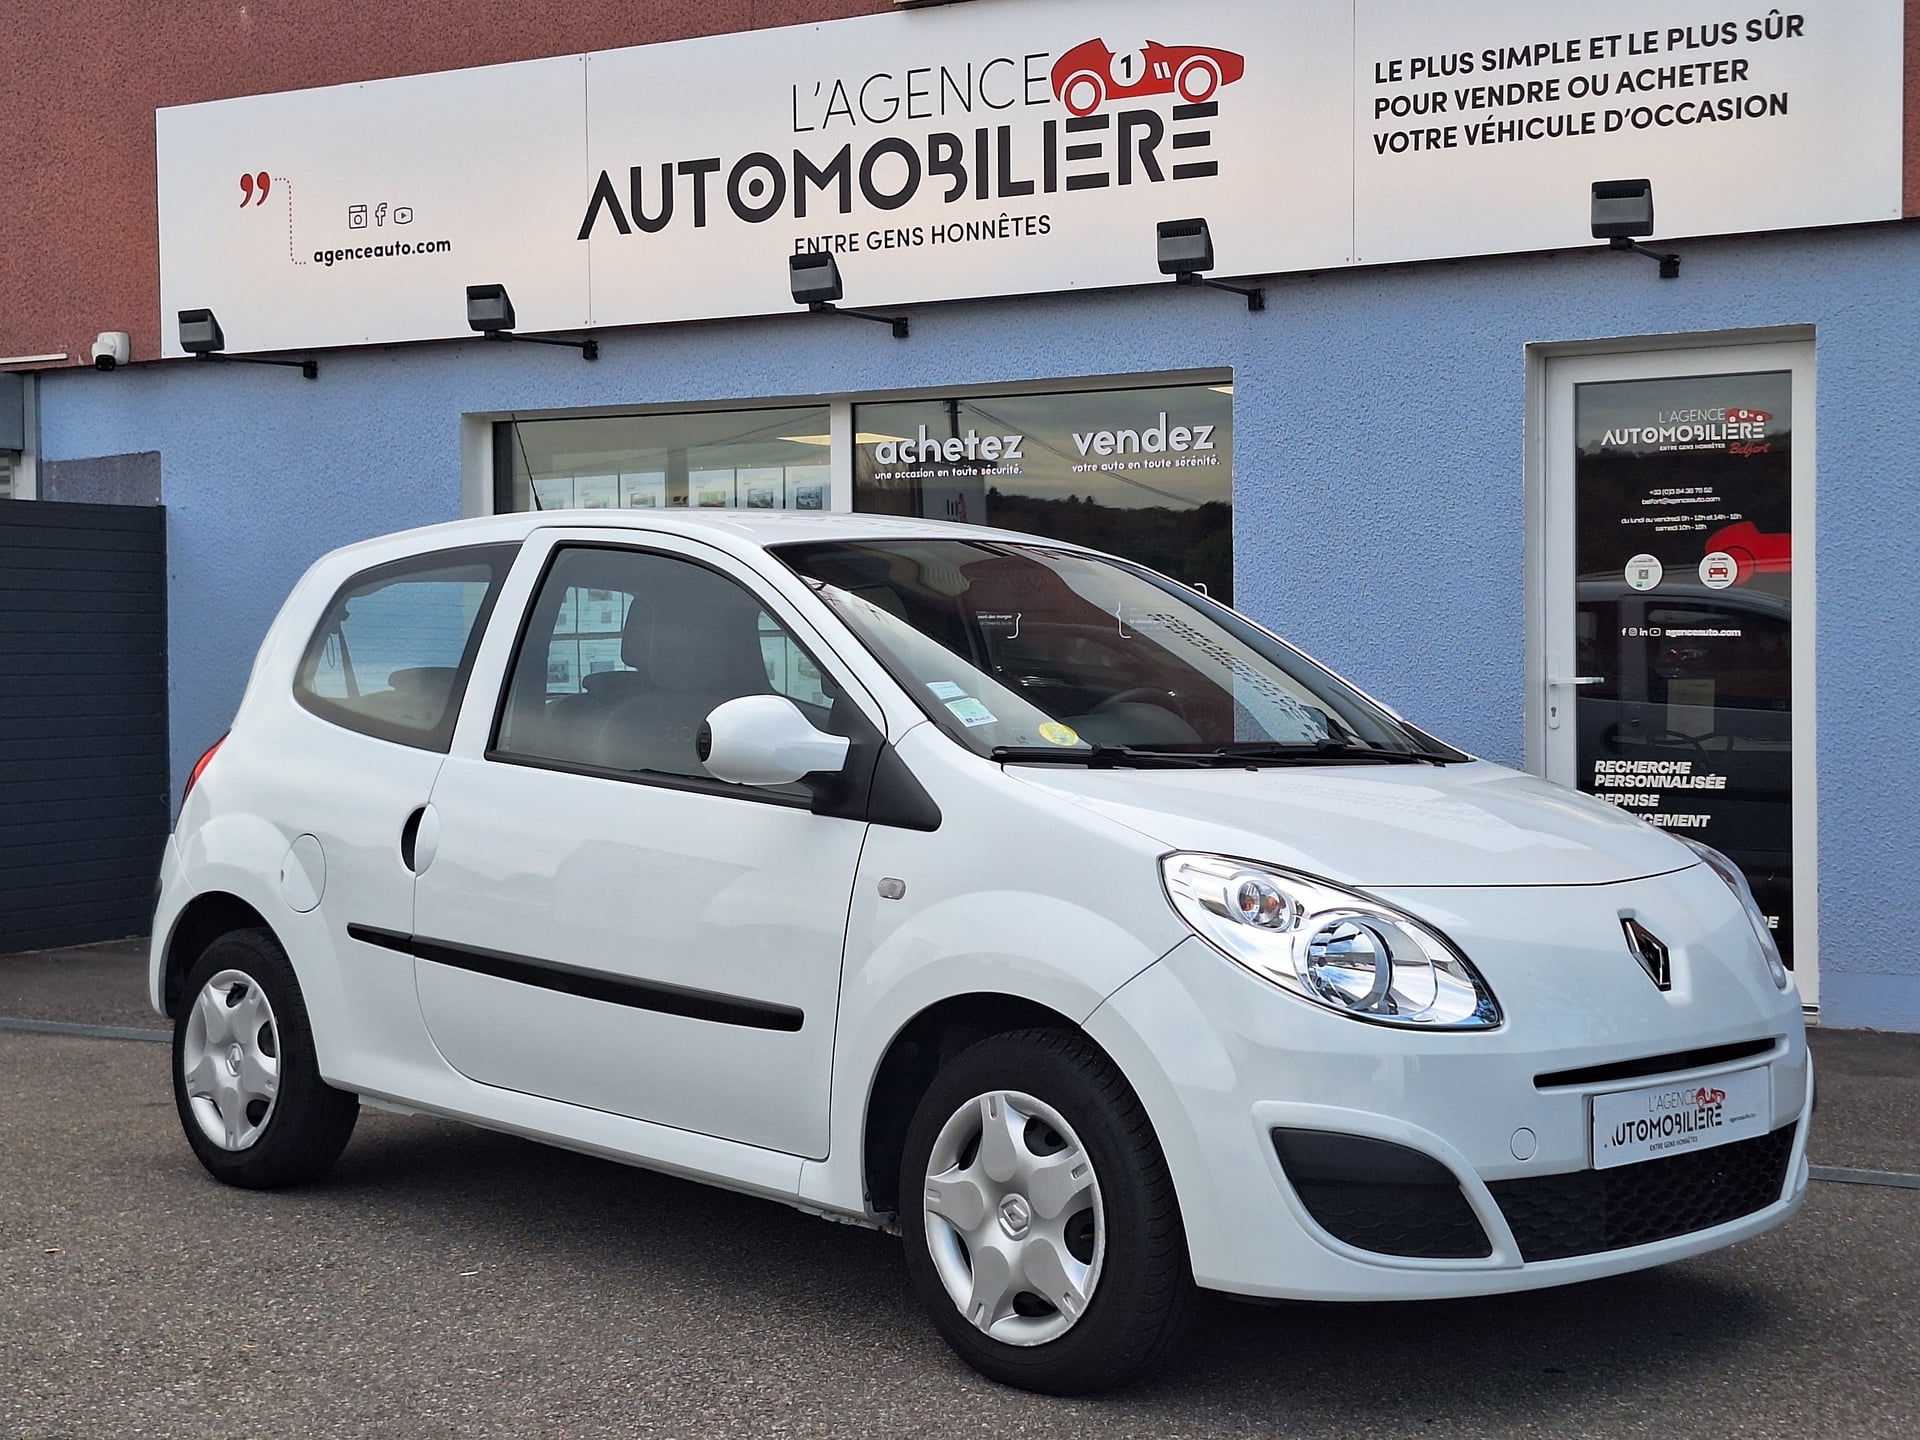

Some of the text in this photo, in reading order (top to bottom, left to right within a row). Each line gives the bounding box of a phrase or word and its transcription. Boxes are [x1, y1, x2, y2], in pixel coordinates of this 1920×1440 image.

[1375, 9, 1805, 83] LE PLUS SIMPLE ET LE PLUS SÛR
[793, 52, 1051, 133] L'AGENCE
[1374, 58, 1749, 119] POUR VENDRE OU ACHETER
[1373, 92, 1788, 155] VOTRE VÉHICULE D'OCCASION
[313, 239, 451, 267] agenceauto.com
[794, 212, 1051, 254] ENTRE GENS HONNÊTES
[874, 424, 1024, 466] achetez
[1072, 411, 1216, 457] vendez
[875, 472, 892, 480] une
[895, 470, 936, 479] occasion
[952, 466, 978, 477] toute
[1072, 462, 1098, 473] votre
[1101, 461, 1126, 471] auto
[1128, 461, 1141, 470] en
[1144, 458, 1172, 469] toute
[1594, 760, 1692, 774] RECHERCHE
[1594, 773, 1727, 789] PERSONNALISÉE
